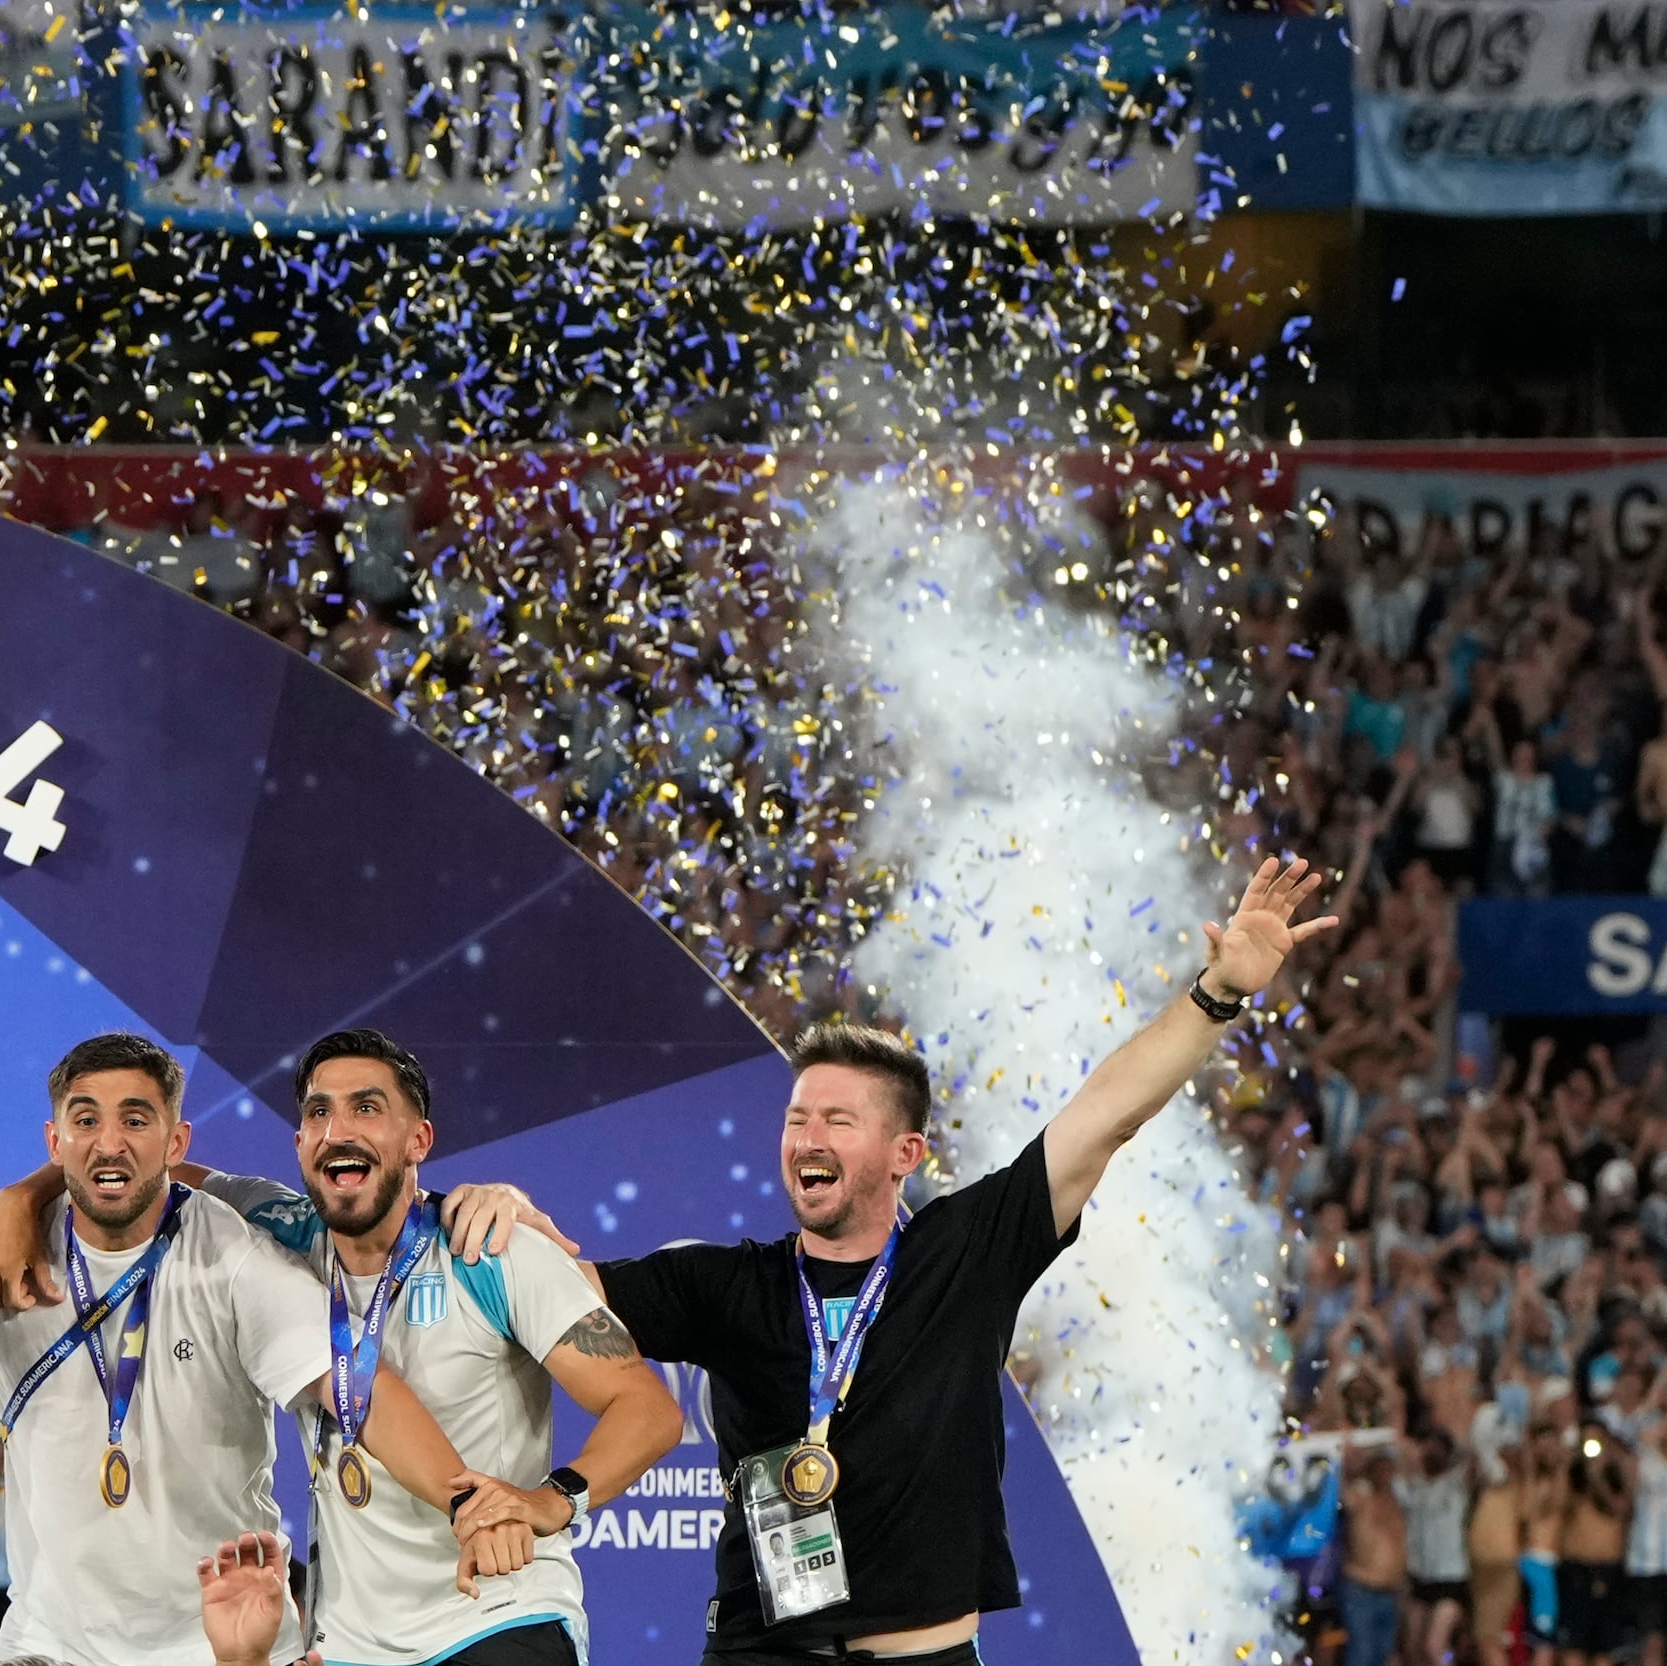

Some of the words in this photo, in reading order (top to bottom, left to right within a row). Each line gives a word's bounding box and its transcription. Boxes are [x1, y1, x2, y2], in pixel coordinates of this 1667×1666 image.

[1377, 8, 1532, 92] NOS
[411, 1236, 429, 1260] 2024
[106, 1286, 128, 1308] FINAL
[126, 1266, 147, 1288] 2024
[826, 1300, 855, 1308] RACIN
[861, 1266, 887, 1312] CONMEBOL
[368, 1290, 387, 1335] CONMEBOL
[20, 1340, 74, 1396] SUDAMERICANA
[813, 1325, 825, 1372] CONMEBOL
[830, 1312, 863, 1383] SUDAMERICANA
[338, 1356, 350, 1414] CONMEBOL
